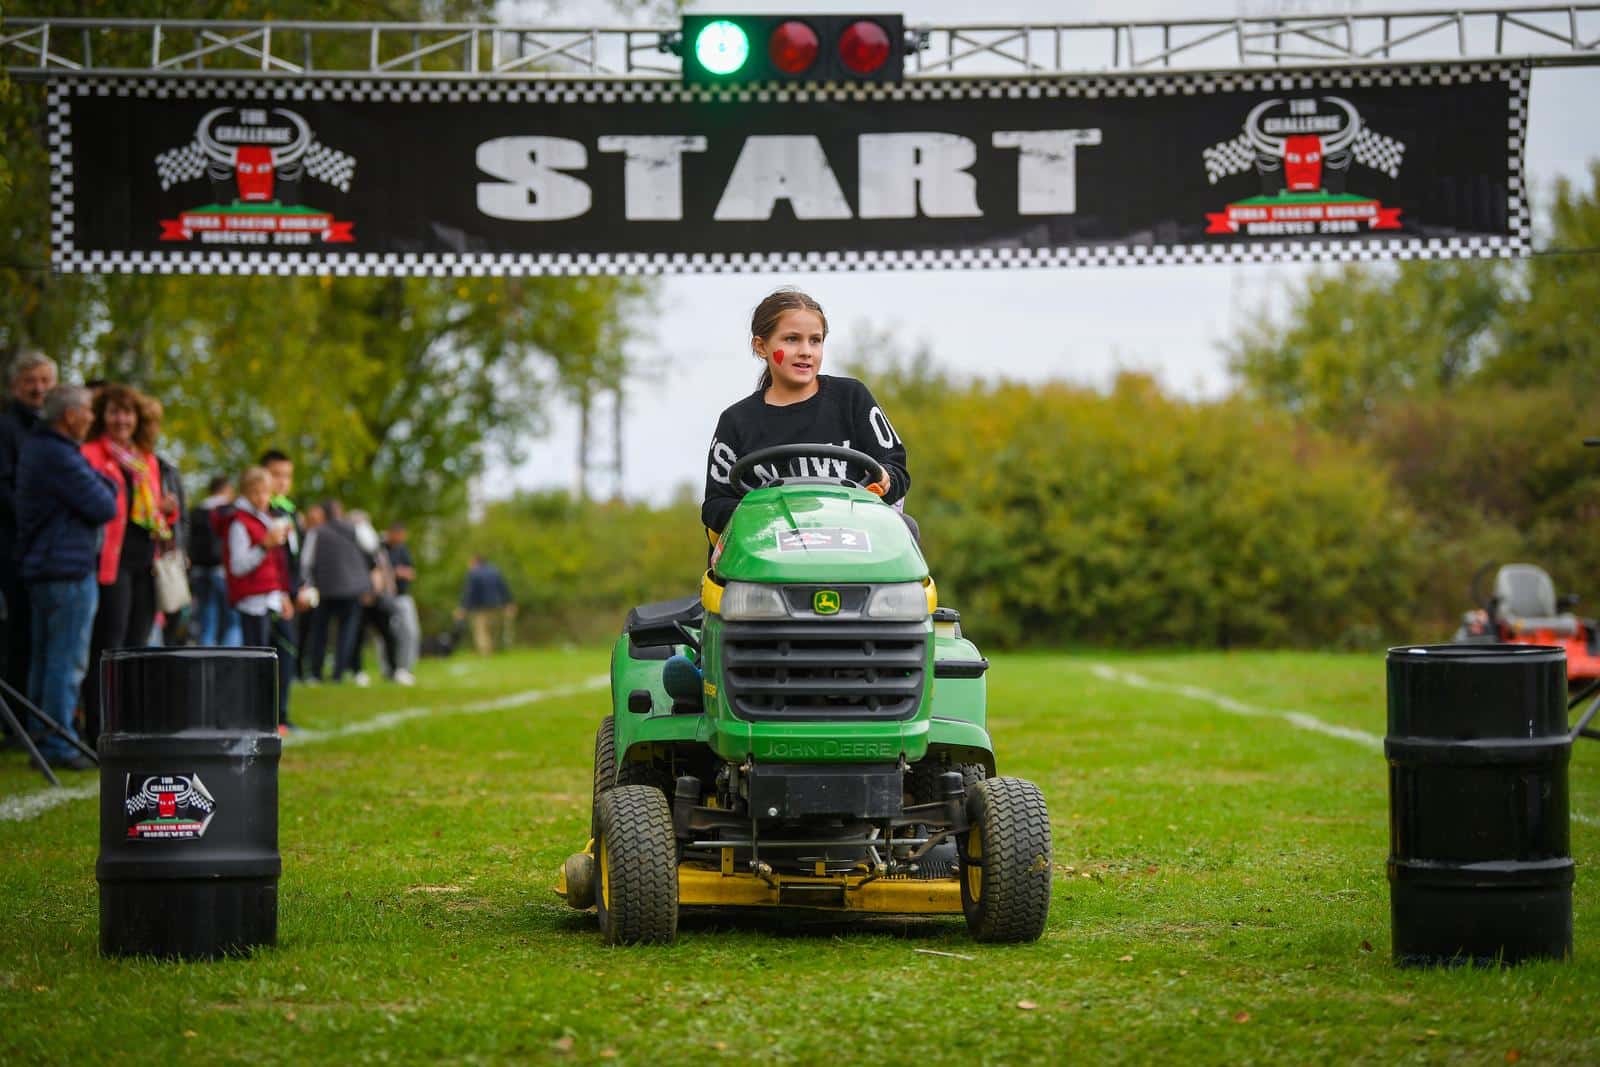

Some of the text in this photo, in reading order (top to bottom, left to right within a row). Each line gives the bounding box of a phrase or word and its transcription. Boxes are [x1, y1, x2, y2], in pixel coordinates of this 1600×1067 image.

[1263, 115, 1342, 134] CHALLENGE
[214, 126, 292, 143] CHALLENGE
[476, 129, 1101, 220] START
[841, 533, 857, 545] 2
[762, 739, 893, 757] JOHN DEERE
[150, 784, 185, 793] CHALLENGE
